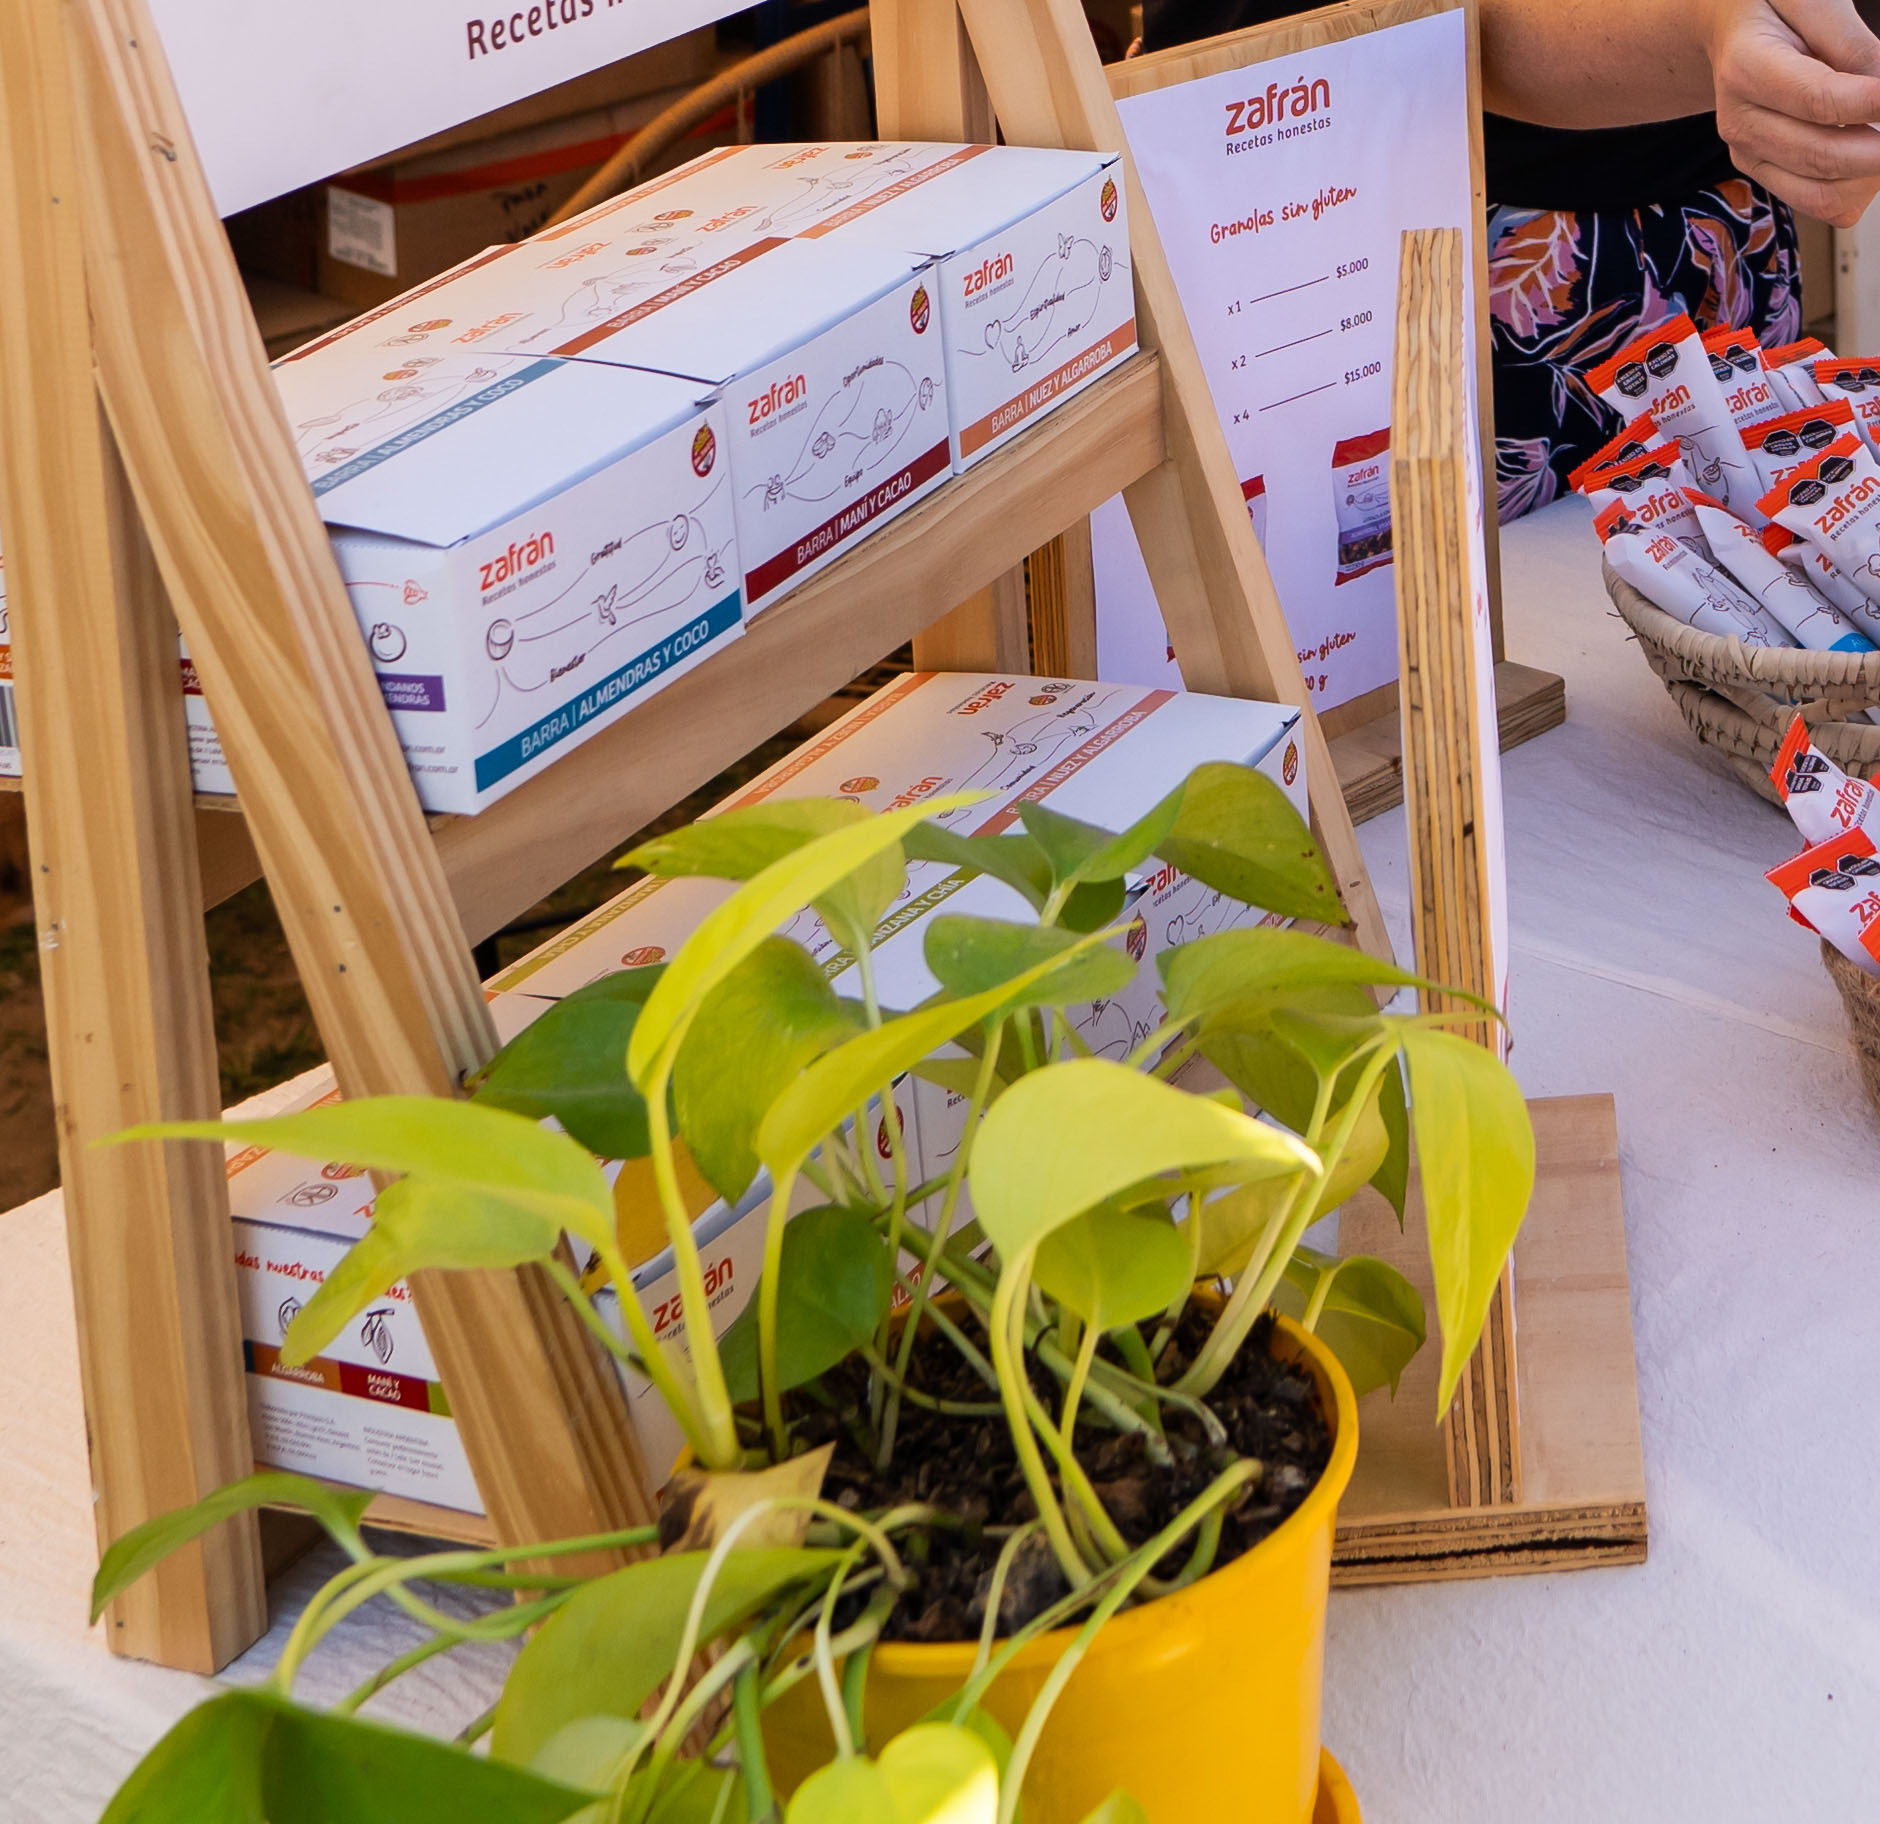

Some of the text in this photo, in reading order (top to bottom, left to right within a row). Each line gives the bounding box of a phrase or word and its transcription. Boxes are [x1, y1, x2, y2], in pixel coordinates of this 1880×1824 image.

[1225, 75, 1331, 137] zafrán
[1226, 115, 1332, 156] Recetas honestas
[1210, 186, 1358, 246] Granolas sin gluten
[963, 252, 1014, 297] zafrán
[1336, 257, 1370, 280] $5.000
[1340, 310, 1373, 333] $8.000
[748, 373, 808, 425] zafrán
[992, 340, 1114, 435] BARRA NUEZ Y ALGARROBA
[1344, 361, 1382, 386] $15.000
[796, 473, 913, 566] BARRA MANÍ Y CACAO
[1830, 514, 1860, 542] Recetas
[479, 529, 554, 592] zafrán
[1319, 630, 1357, 662] gluten
[521, 619, 710, 759] BARRA ALMENDRAS Y COCO
[1006, 785, 1046, 816] BRRA
[1047, 763, 1076, 786] NUEZ
[1084, 710, 1149, 754] ALGARROBA
[871, 904, 923, 946] ANZANA
[928, 876, 963, 902] CHÍA
[653, 1257, 734, 1335] zaán
